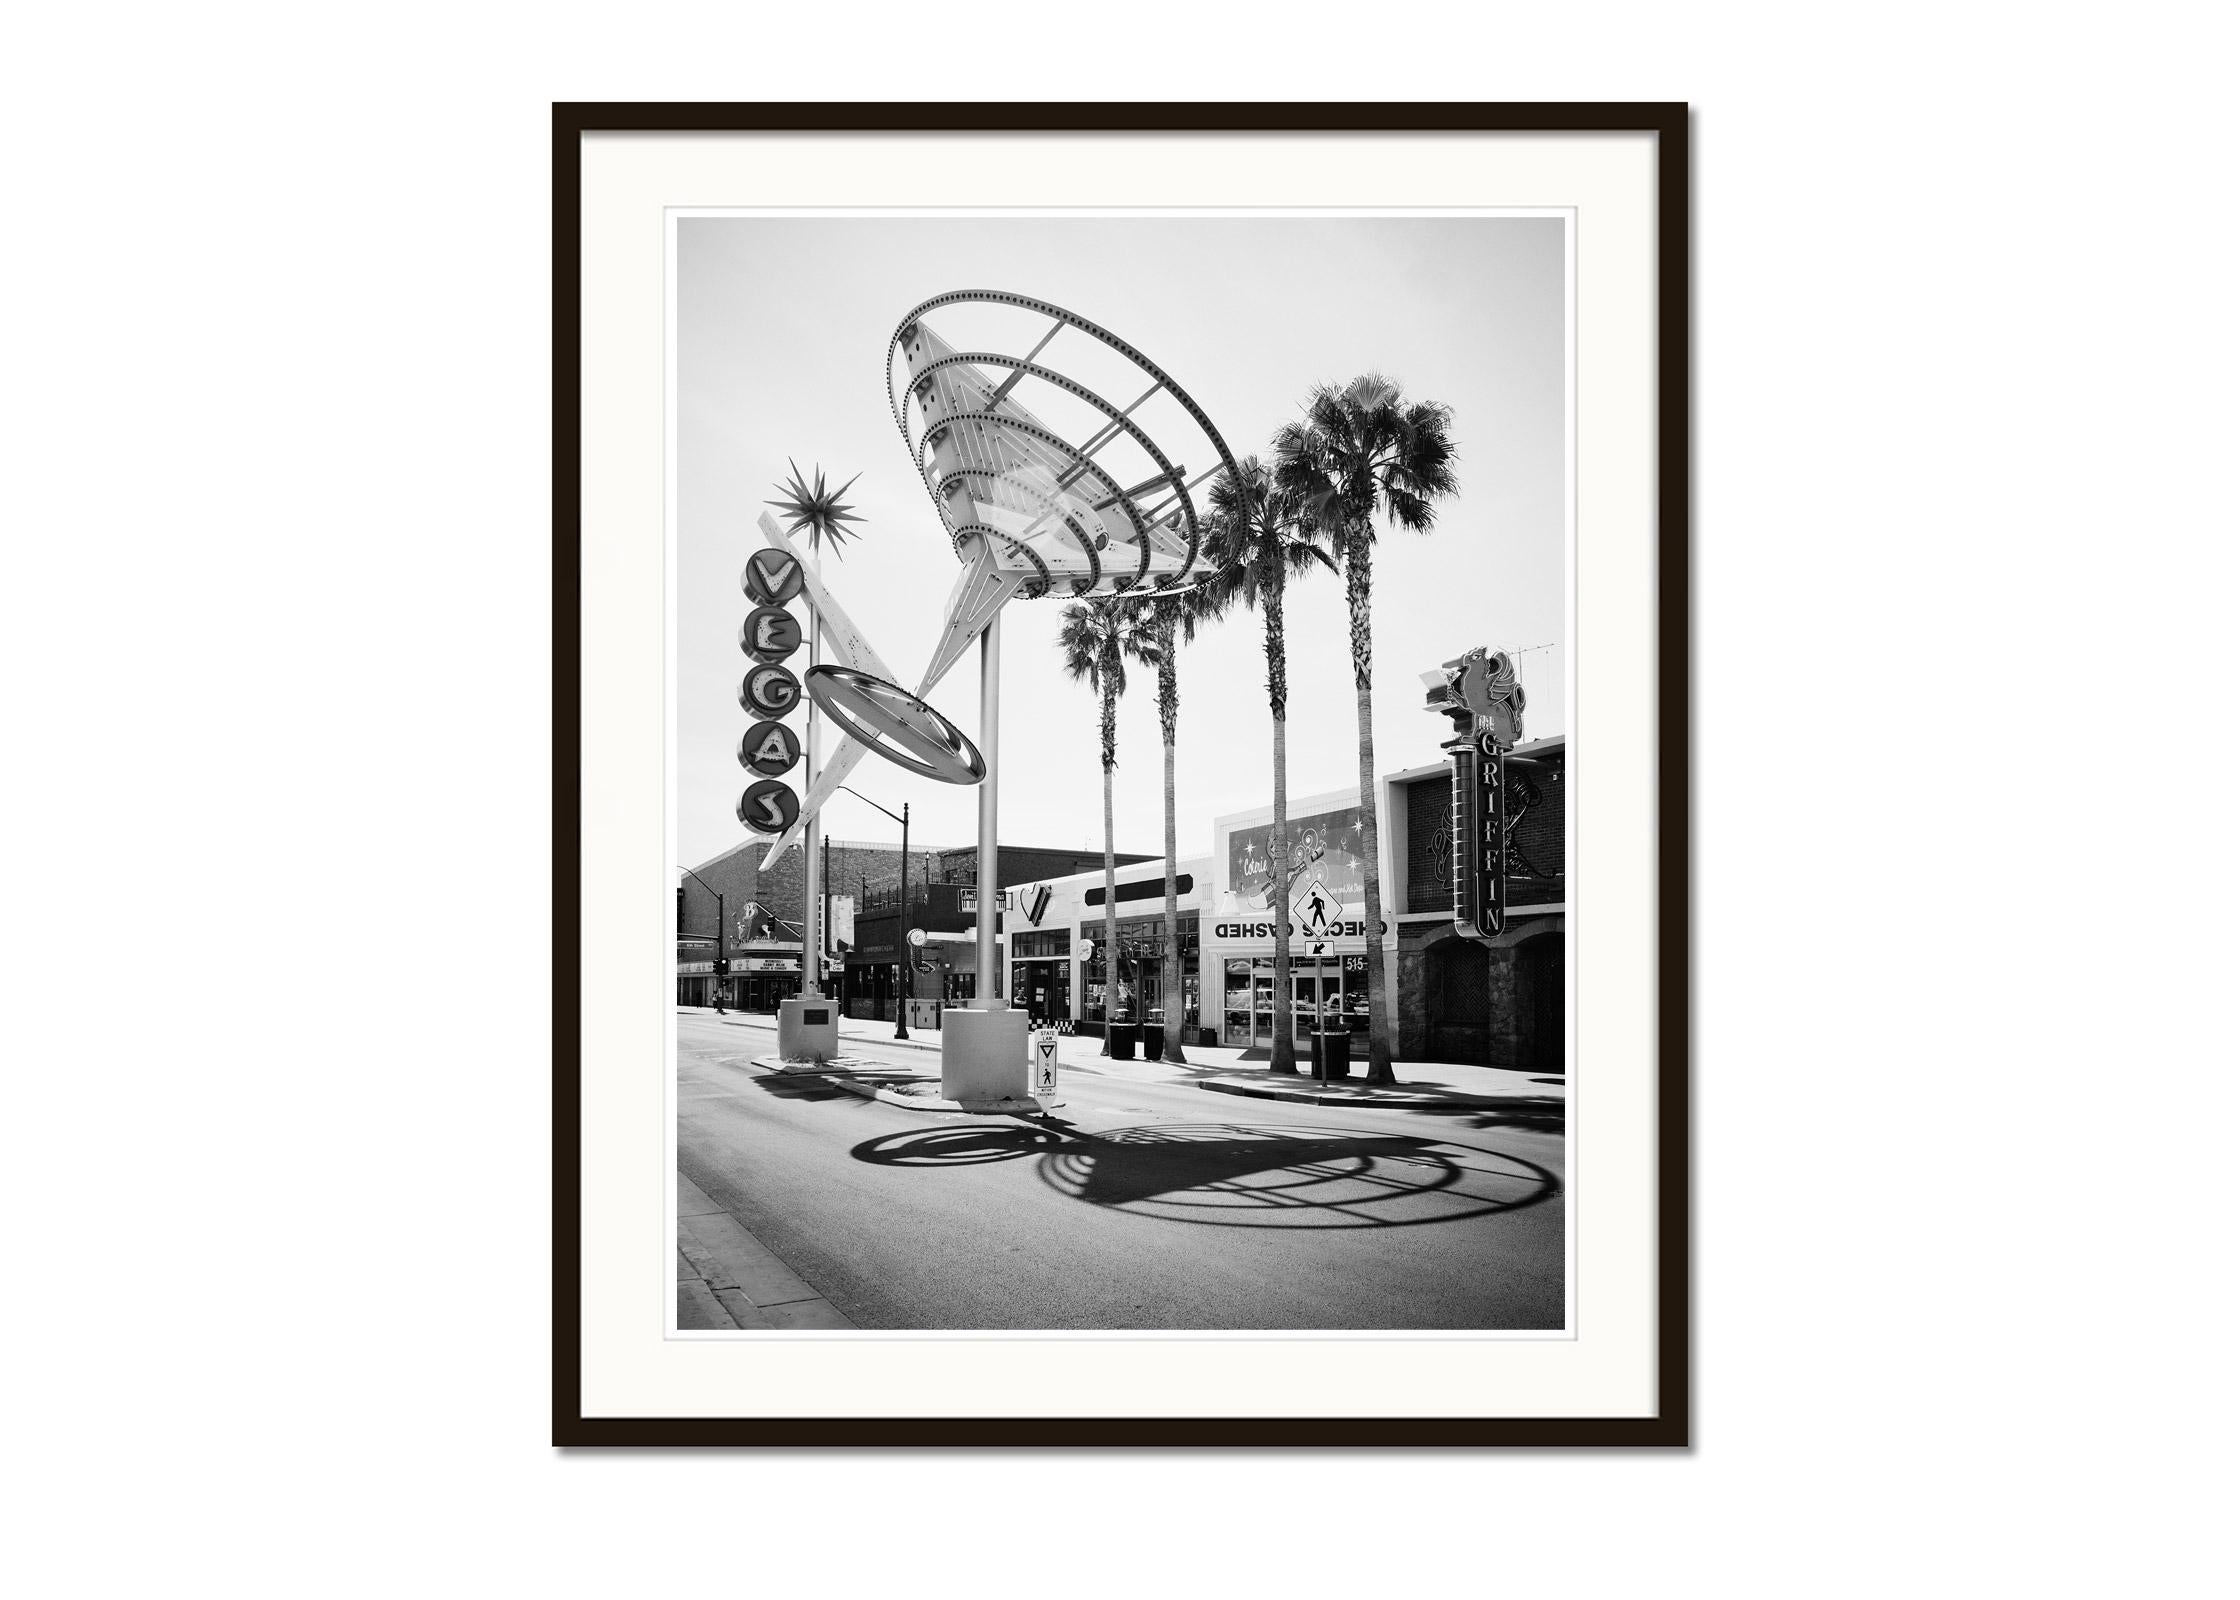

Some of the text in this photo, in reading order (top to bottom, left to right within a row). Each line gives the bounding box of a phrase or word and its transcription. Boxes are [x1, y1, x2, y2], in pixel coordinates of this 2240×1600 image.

[750, 555, 801, 829] VEGAS
[1482, 733, 1500, 931] GRIFFIN
[1347, 957, 1363, 970] 515
